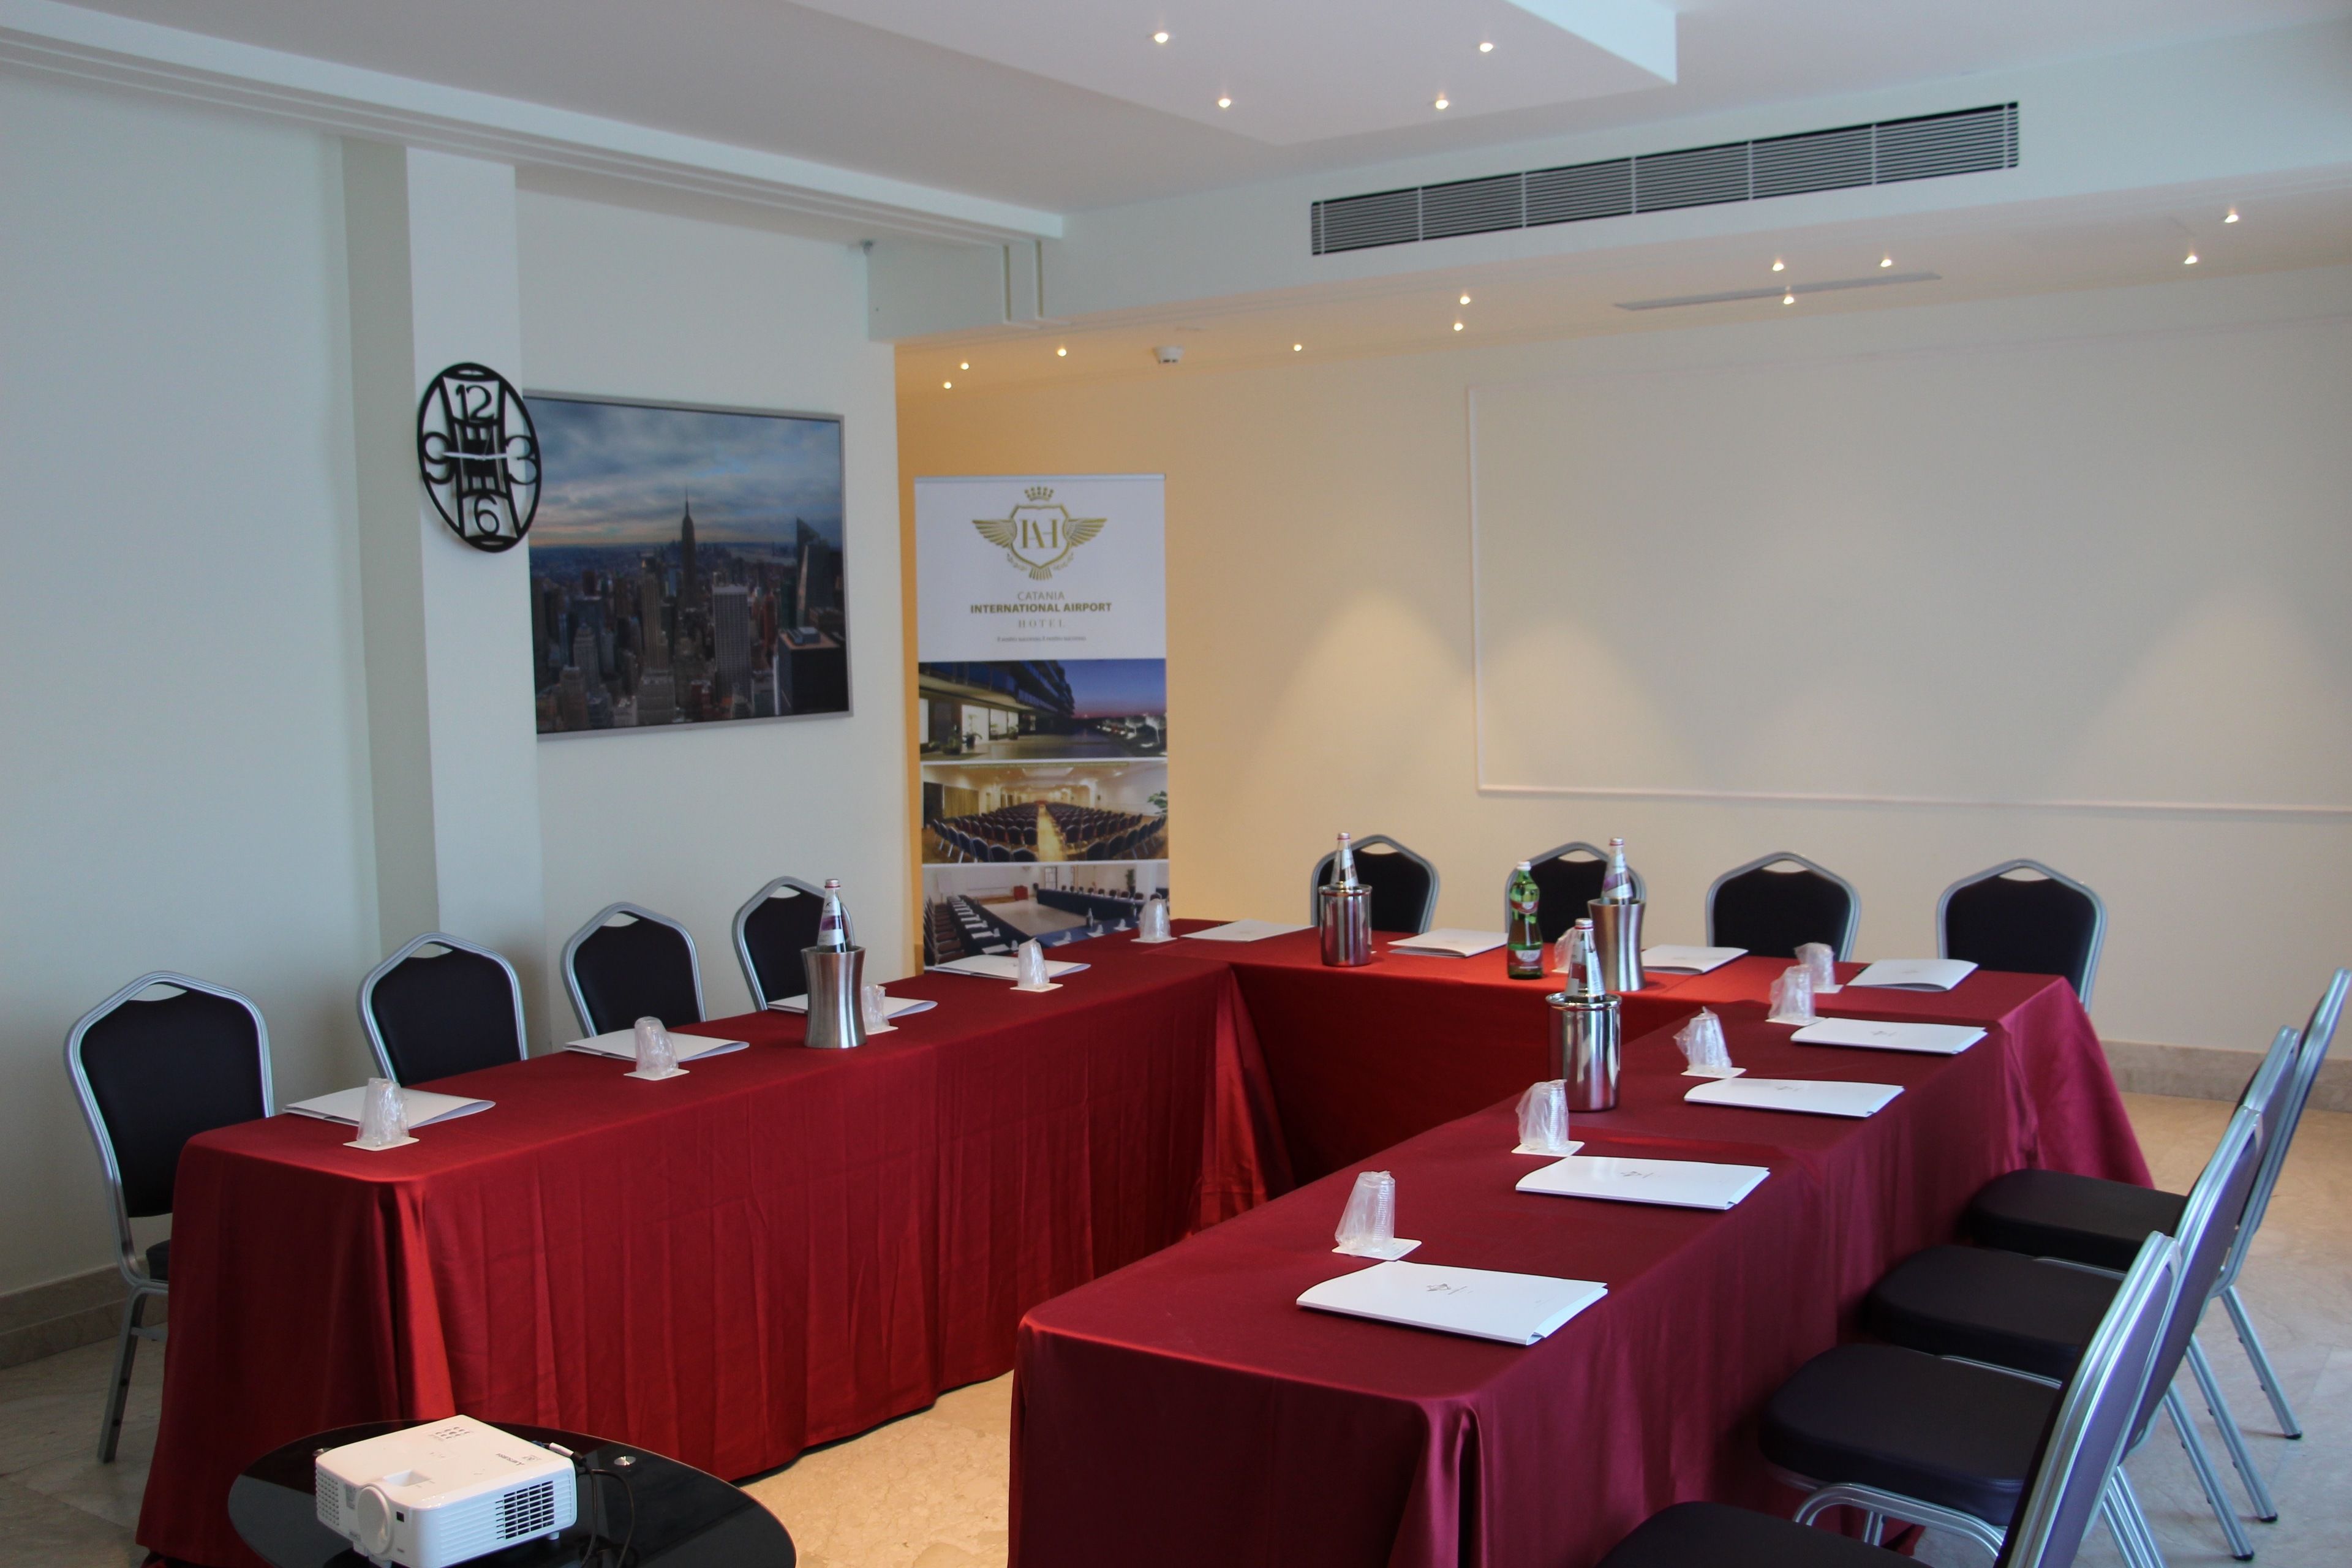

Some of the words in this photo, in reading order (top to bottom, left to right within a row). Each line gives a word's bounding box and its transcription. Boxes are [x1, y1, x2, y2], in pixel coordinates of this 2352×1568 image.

[456, 384, 494, 423] 12
[423, 431, 456, 484] 9
[505, 435, 538, 485] 3
[474, 494, 500, 535] 6
[970, 603, 1061, 614] INTERNATIONAL
[1063, 602, 1112, 612] AIRPORT
[1017, 591, 1065, 601] CATANIA
[1018, 619, 1065, 628] HOTEL
